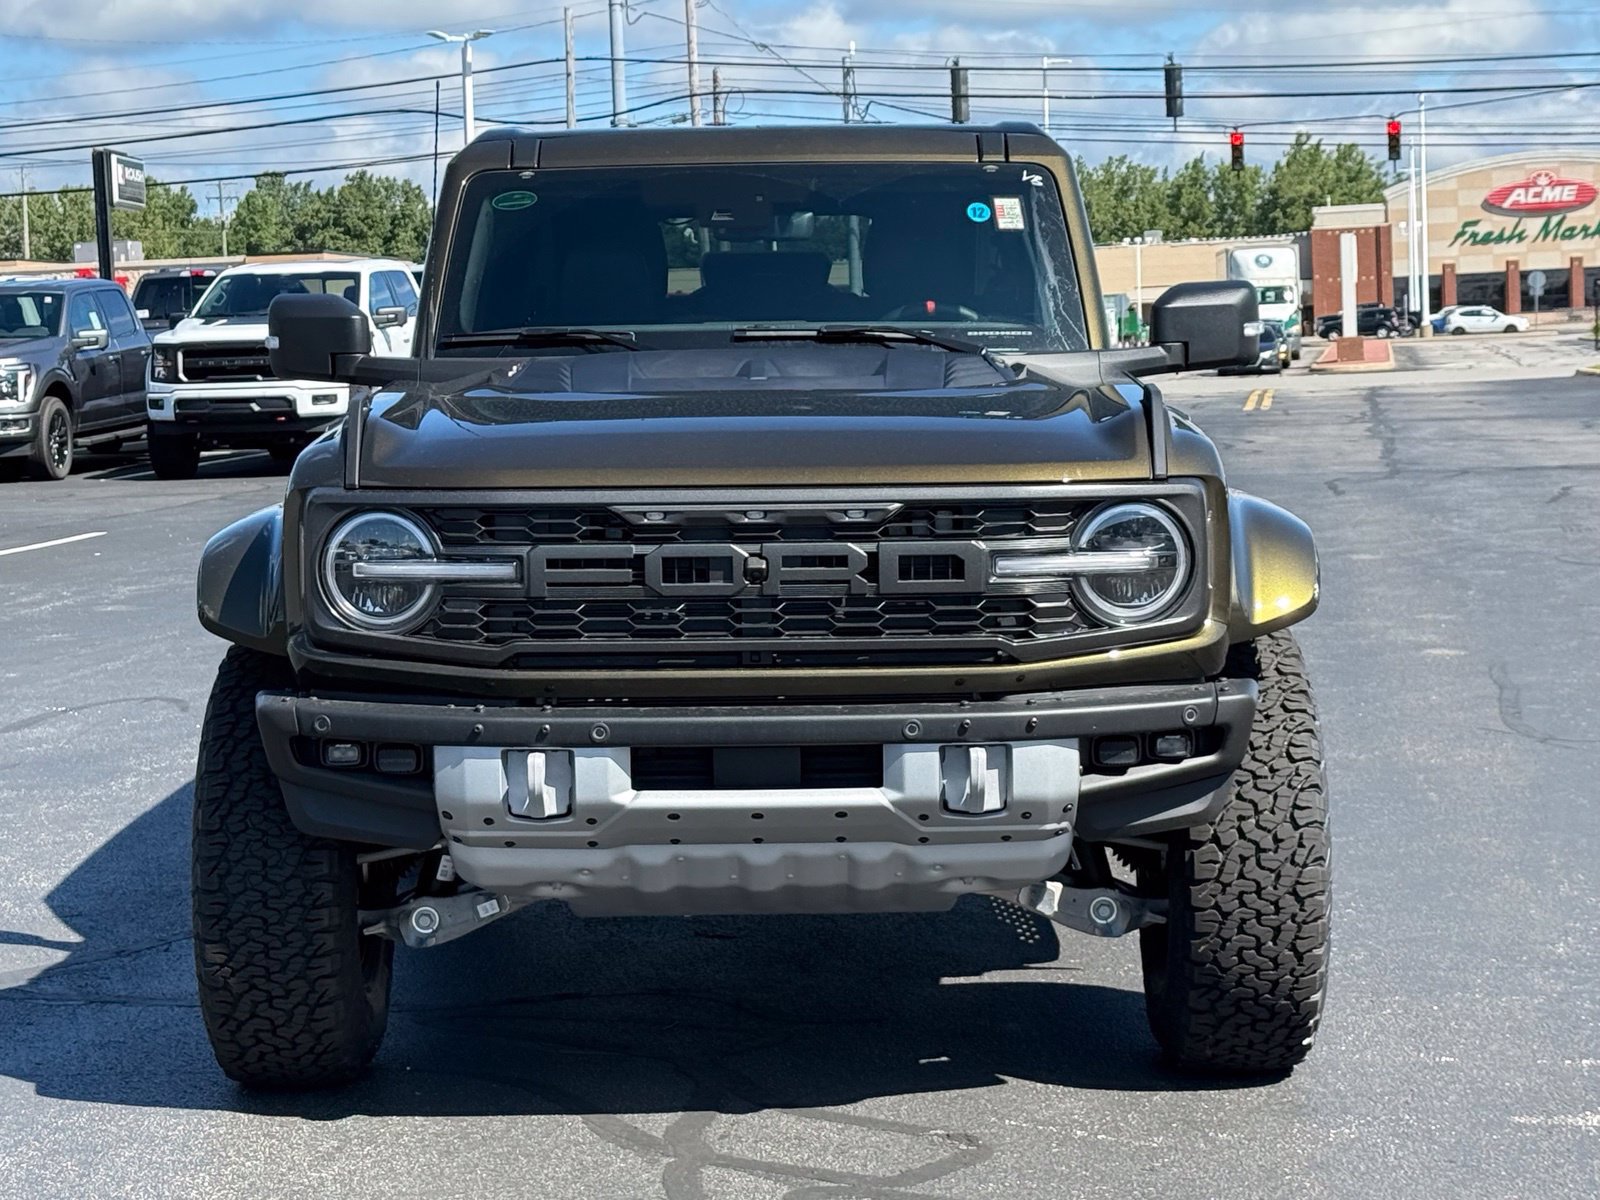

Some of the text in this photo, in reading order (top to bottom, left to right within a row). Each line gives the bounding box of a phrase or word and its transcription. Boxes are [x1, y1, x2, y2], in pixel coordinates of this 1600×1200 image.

[1502, 185, 1579, 208] ACME
[970, 206, 986, 218] 12
[1448, 217, 1529, 248] Fresh
[527, 543, 988, 598] FORD
